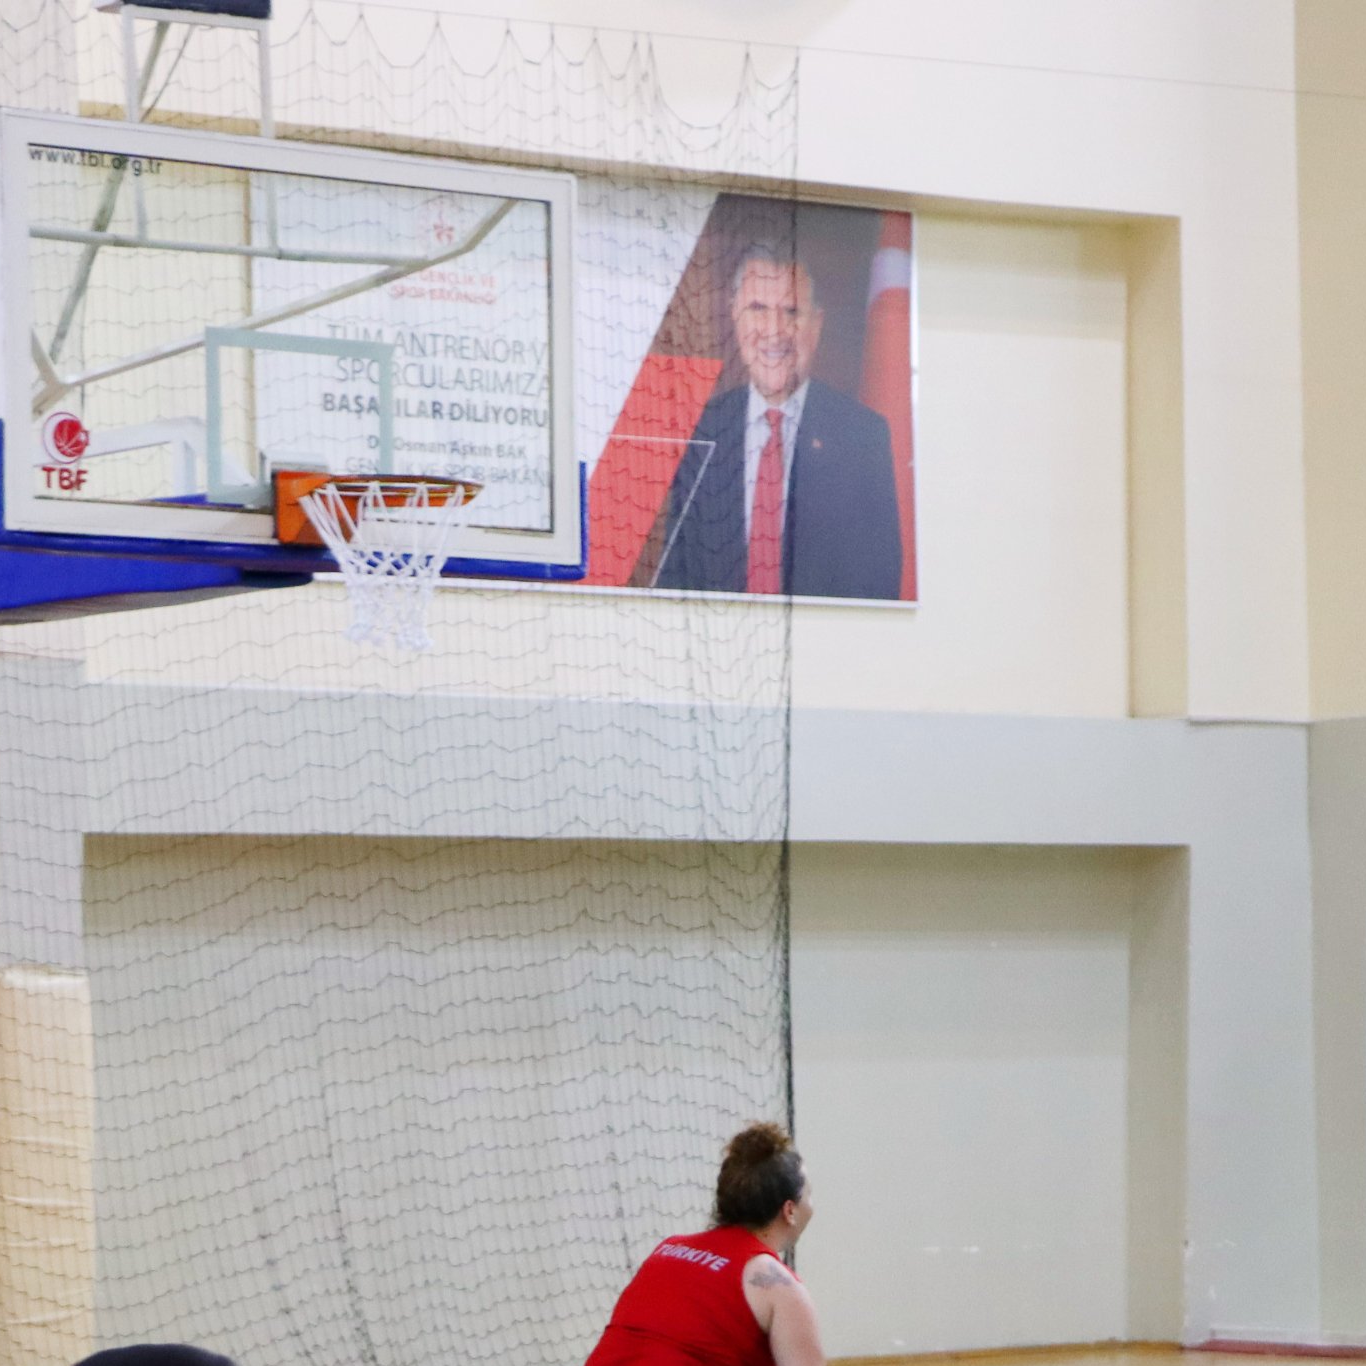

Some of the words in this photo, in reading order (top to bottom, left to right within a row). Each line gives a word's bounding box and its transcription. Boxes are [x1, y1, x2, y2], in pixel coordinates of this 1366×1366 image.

[392, 330, 526, 364] ANTRENÖR
[323, 392, 445, 420] BAŞAILAR
[41, 466, 88, 490] TBF
